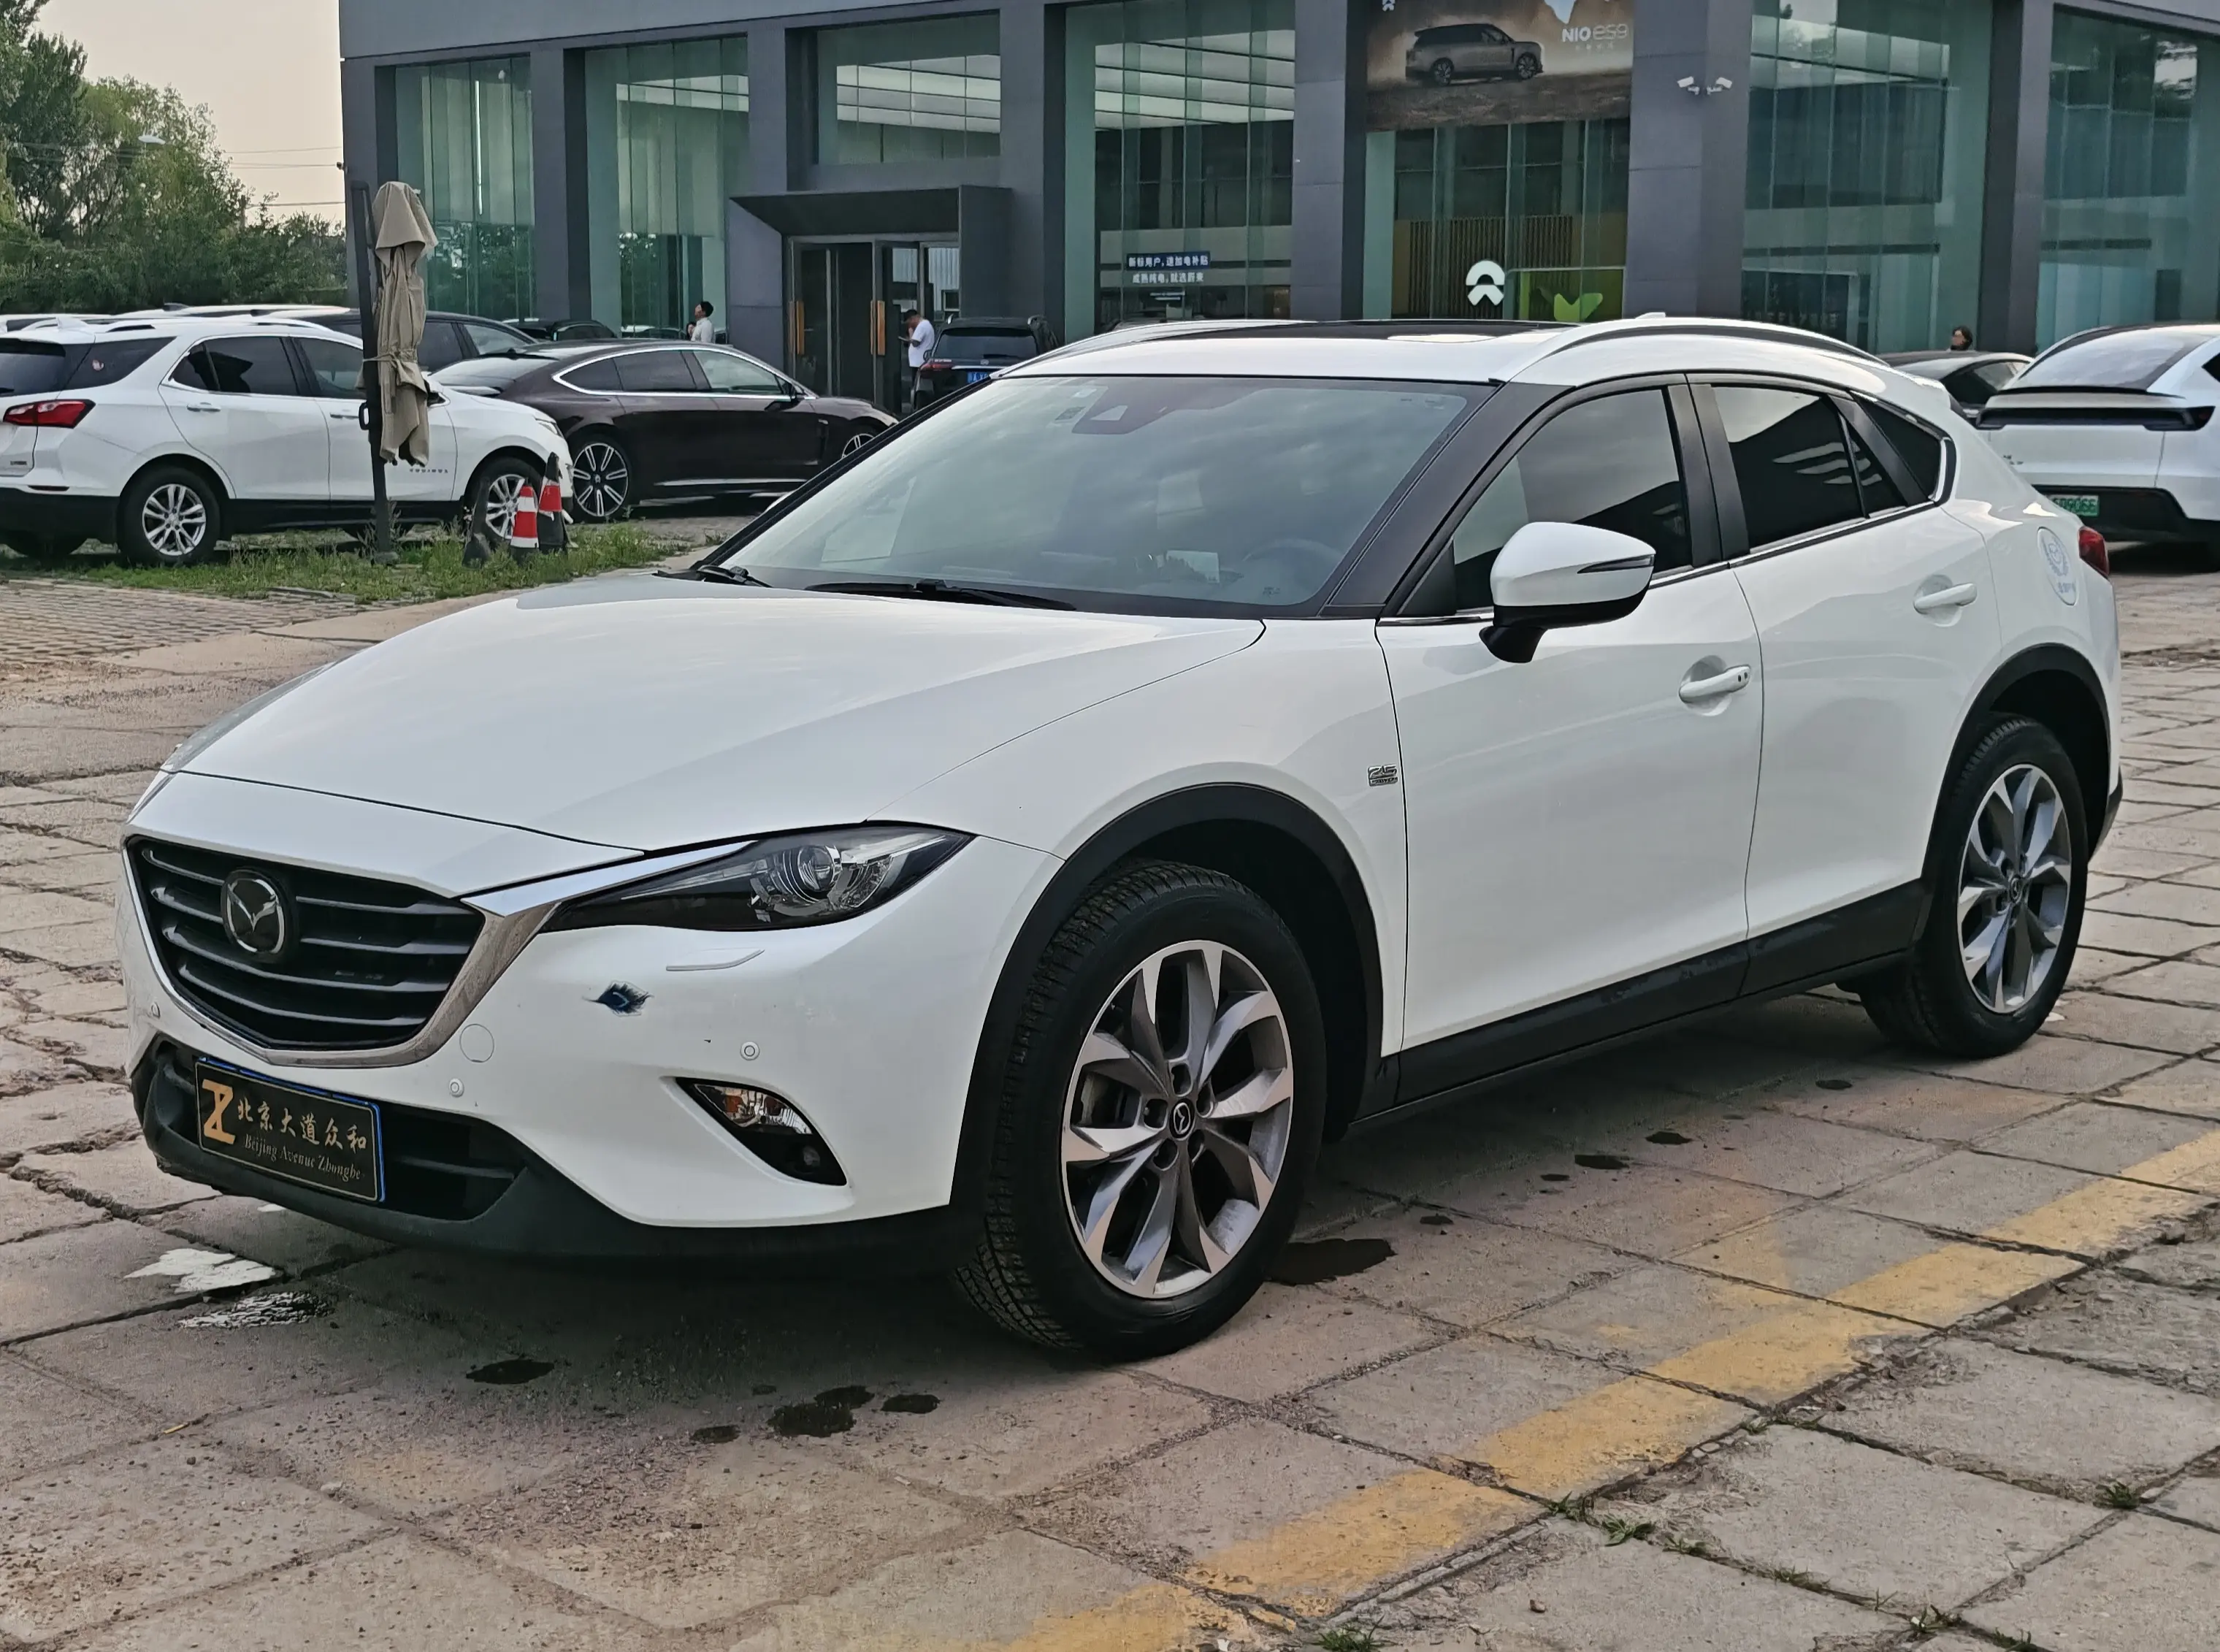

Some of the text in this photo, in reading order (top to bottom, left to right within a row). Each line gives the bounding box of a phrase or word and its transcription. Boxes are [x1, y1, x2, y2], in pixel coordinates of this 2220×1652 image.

[1562, 26, 1591, 42] NIO
[237, 1095, 367, 1153] 北京大道众和
[245, 1133, 361, 1182] Beijing Avenue Zhonghe
